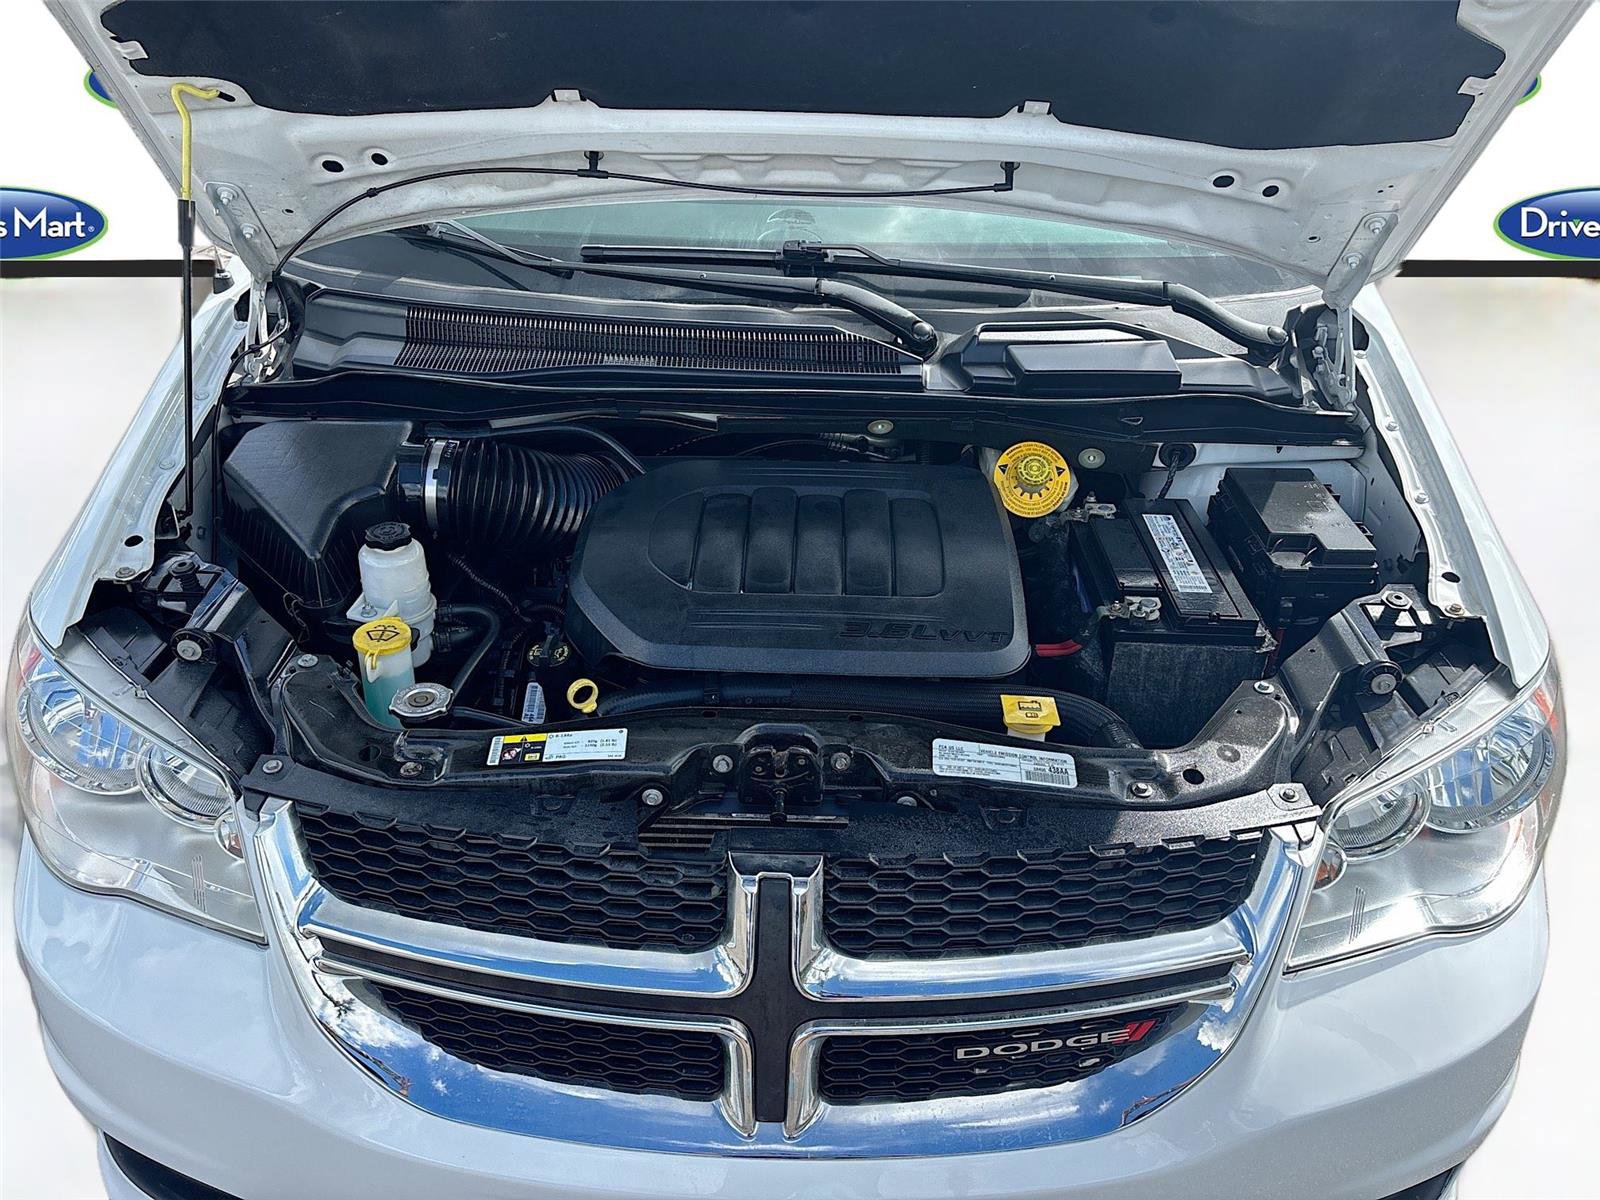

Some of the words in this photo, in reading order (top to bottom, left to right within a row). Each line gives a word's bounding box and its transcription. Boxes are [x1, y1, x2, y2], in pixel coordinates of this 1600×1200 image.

[14, 206, 86, 238] Mart
[1521, 206, 1600, 237] Drive
[956, 1029, 1130, 1060] DODGE
